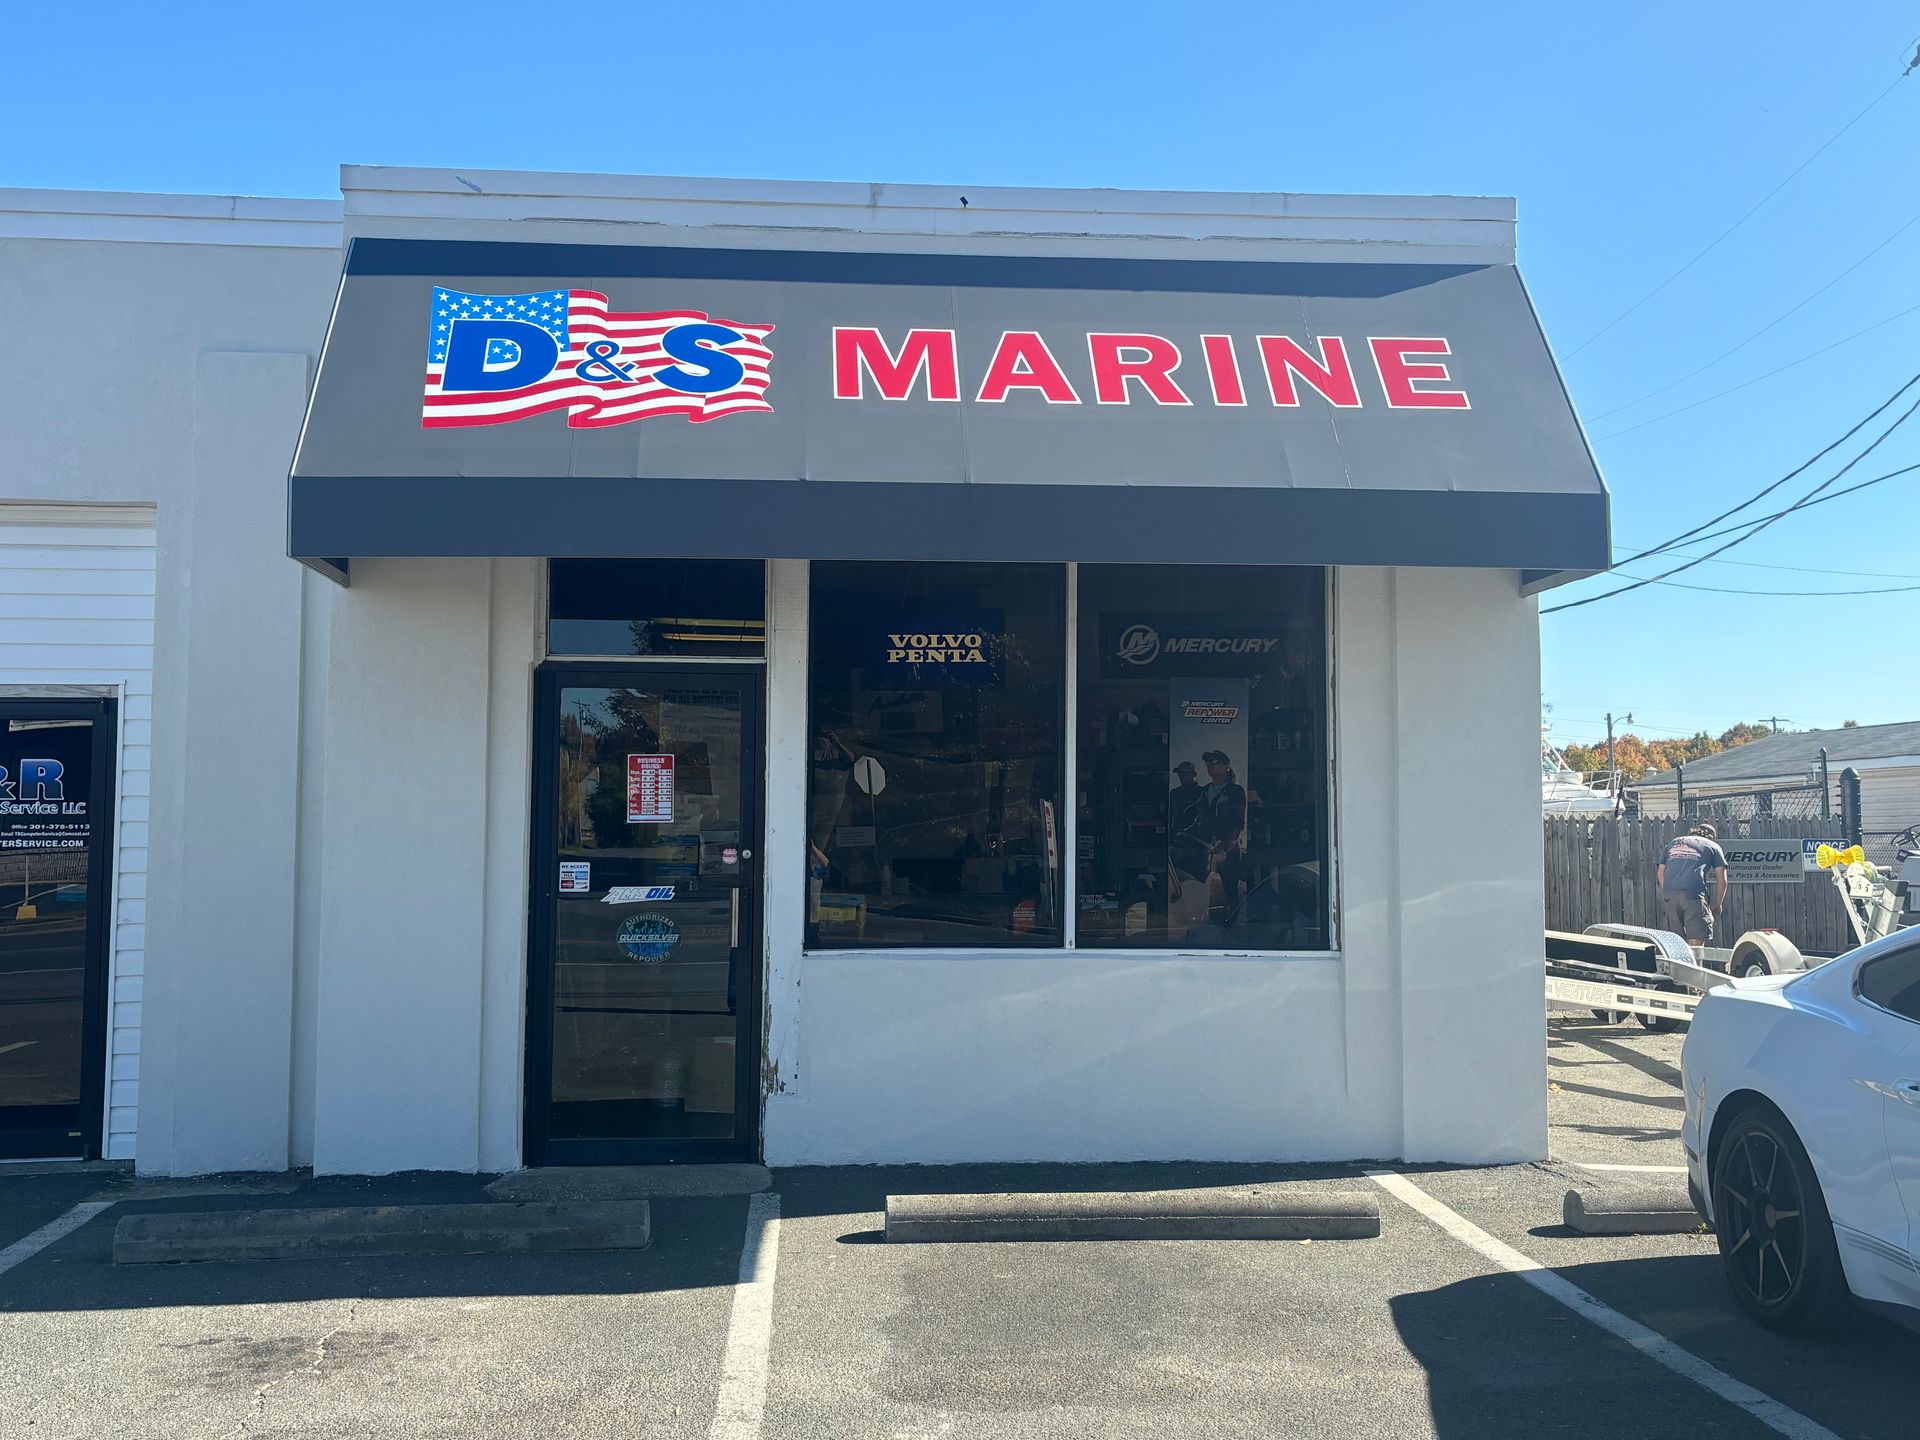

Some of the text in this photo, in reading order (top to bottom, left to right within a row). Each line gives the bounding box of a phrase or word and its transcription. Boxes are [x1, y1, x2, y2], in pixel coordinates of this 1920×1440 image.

[830, 325, 1473, 411] MARINE
[888, 634, 982, 648] VOLVO
[1164, 638, 1279, 653] MERCURY
[887, 649, 986, 663] PENTA
[1186, 708, 1236, 716] REPOWER
[0, 801, 87, 815] Service LLC
[603, 886, 674, 903] AMSOIL
[625, 914, 675, 928] AUTHORIZED
[618, 933, 681, 944] QUICKSILVER
[627, 950, 672, 963] REPOWER
[1554, 981, 1614, 1005] VENTURE
